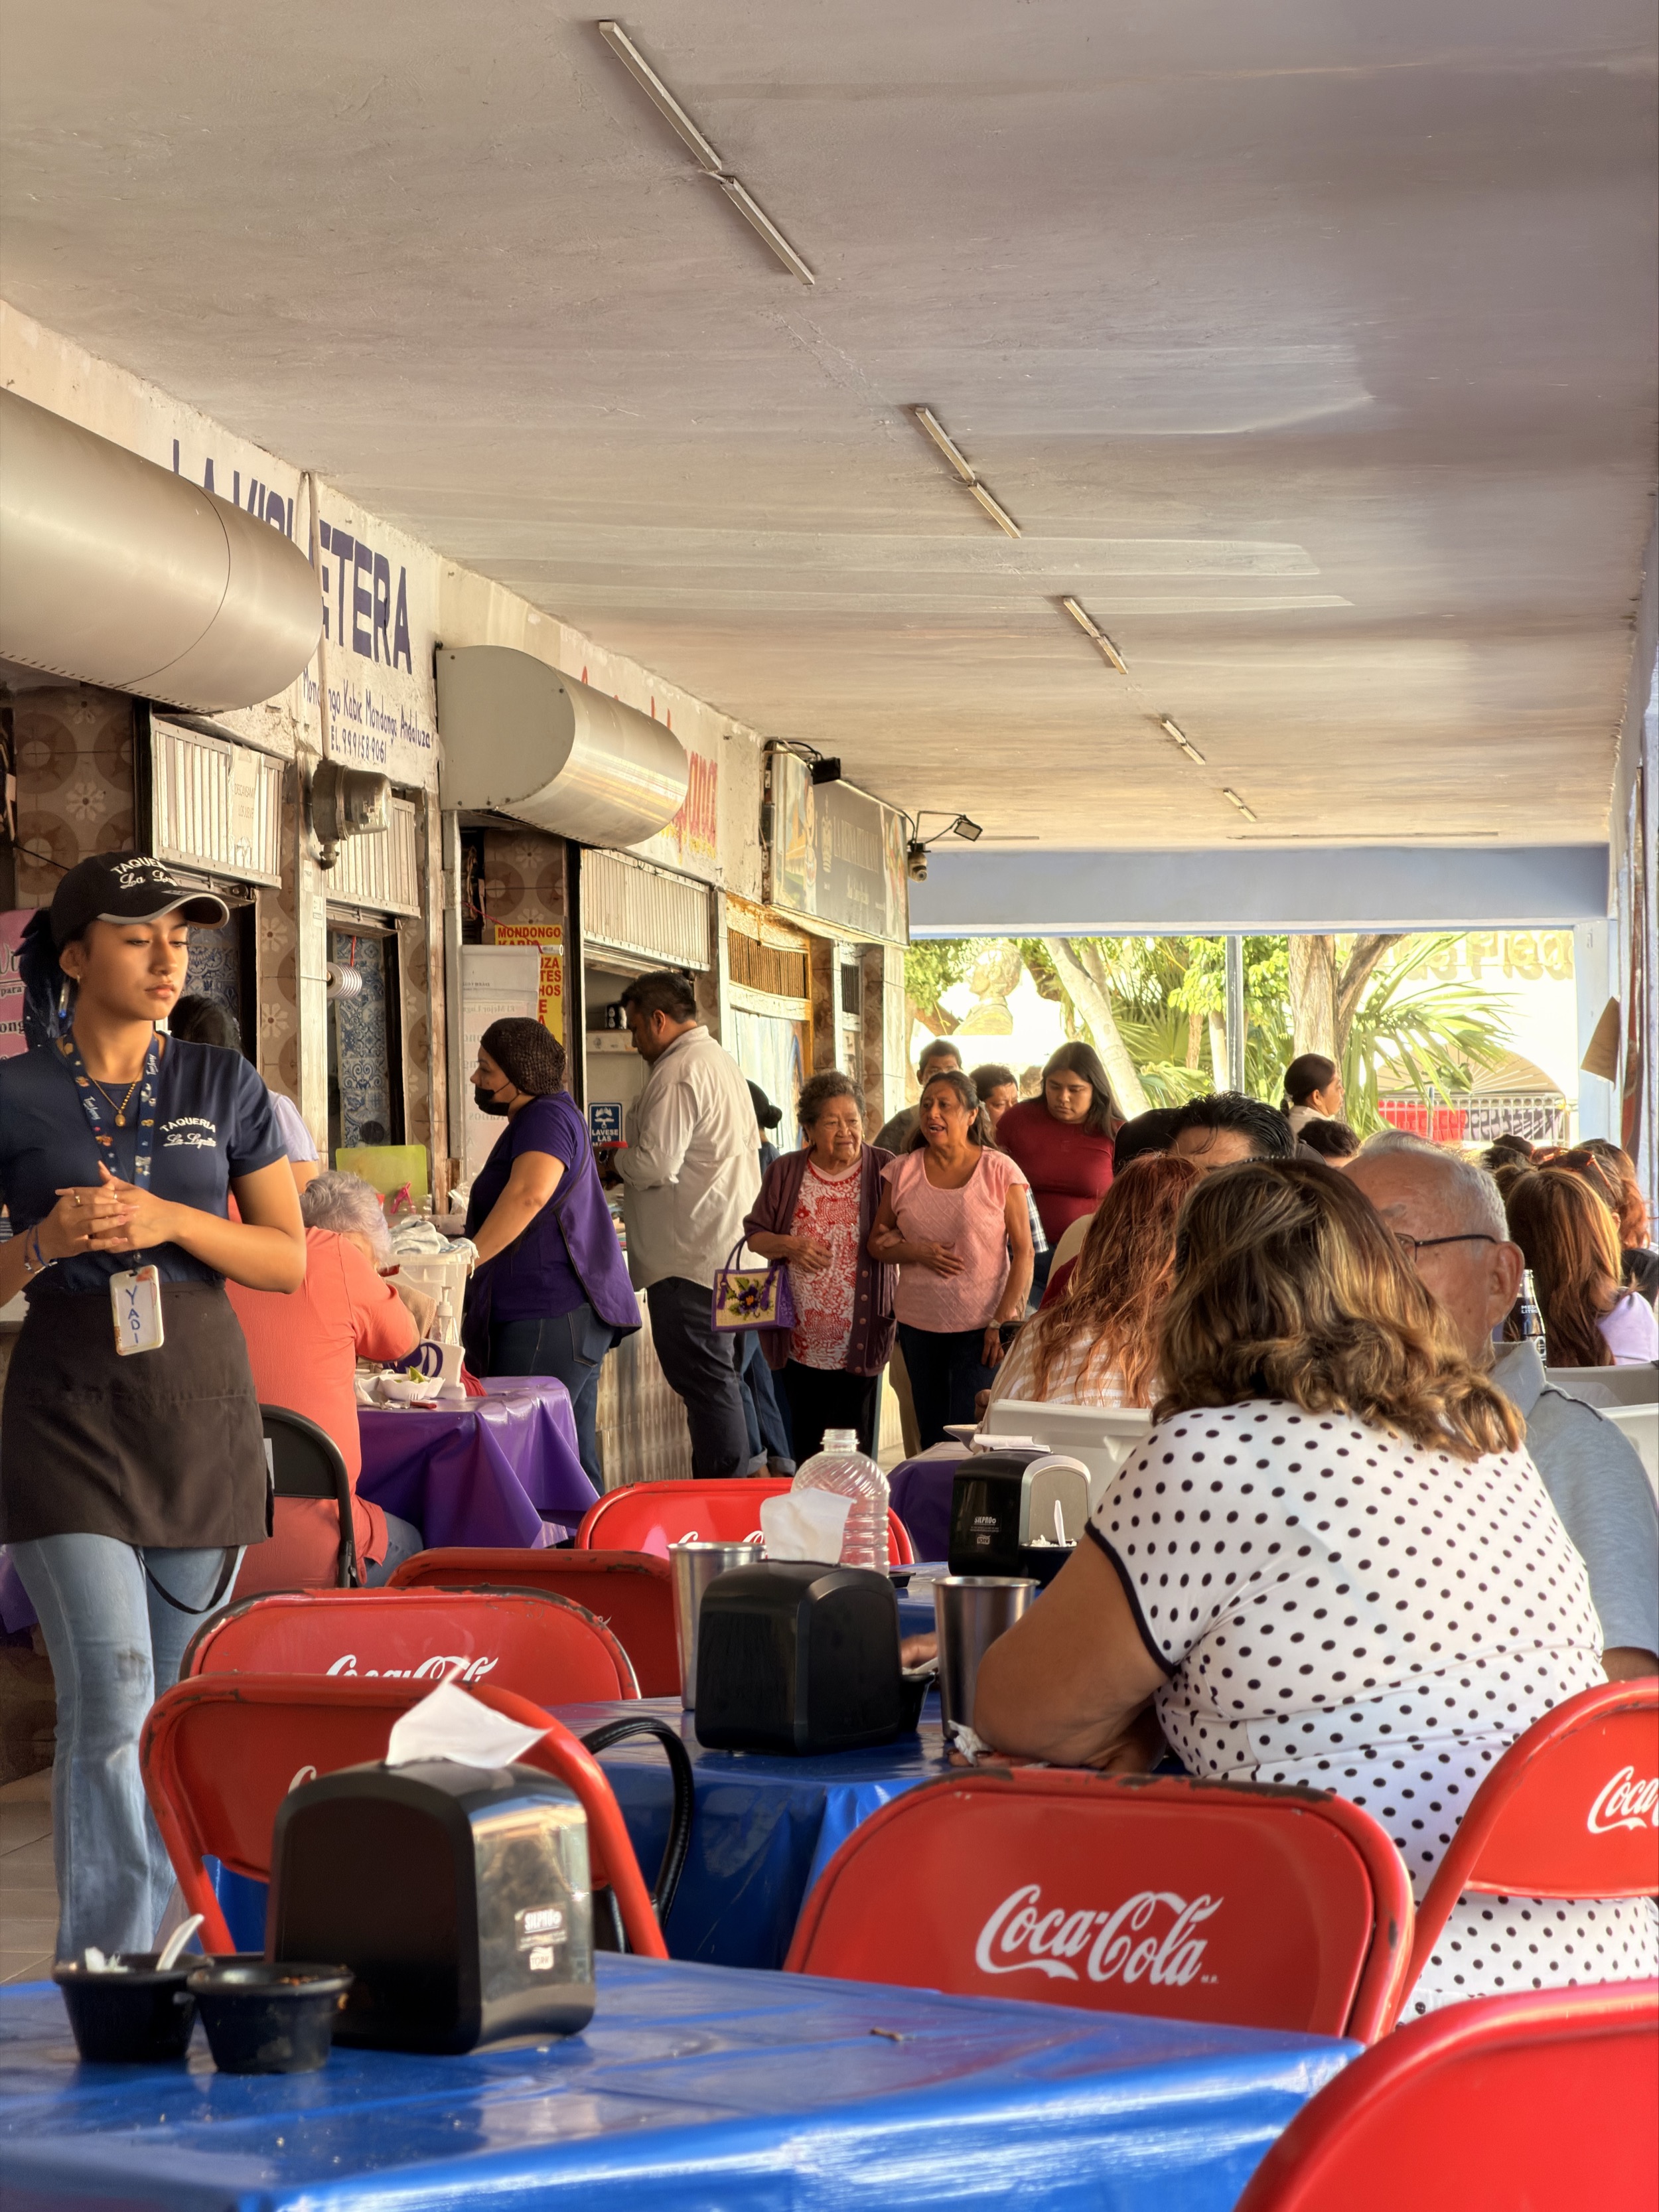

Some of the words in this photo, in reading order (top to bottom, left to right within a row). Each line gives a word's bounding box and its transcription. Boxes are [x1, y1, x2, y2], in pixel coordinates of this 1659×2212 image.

[400, 704, 431, 749] Andaluza
[498, 926, 561, 938] MONDONGO
[159, 1117, 216, 1133] TAQUERIA
[125, 1285, 141, 1344] YADI
[975, 1884, 1224, 1986] Coca-Cola
